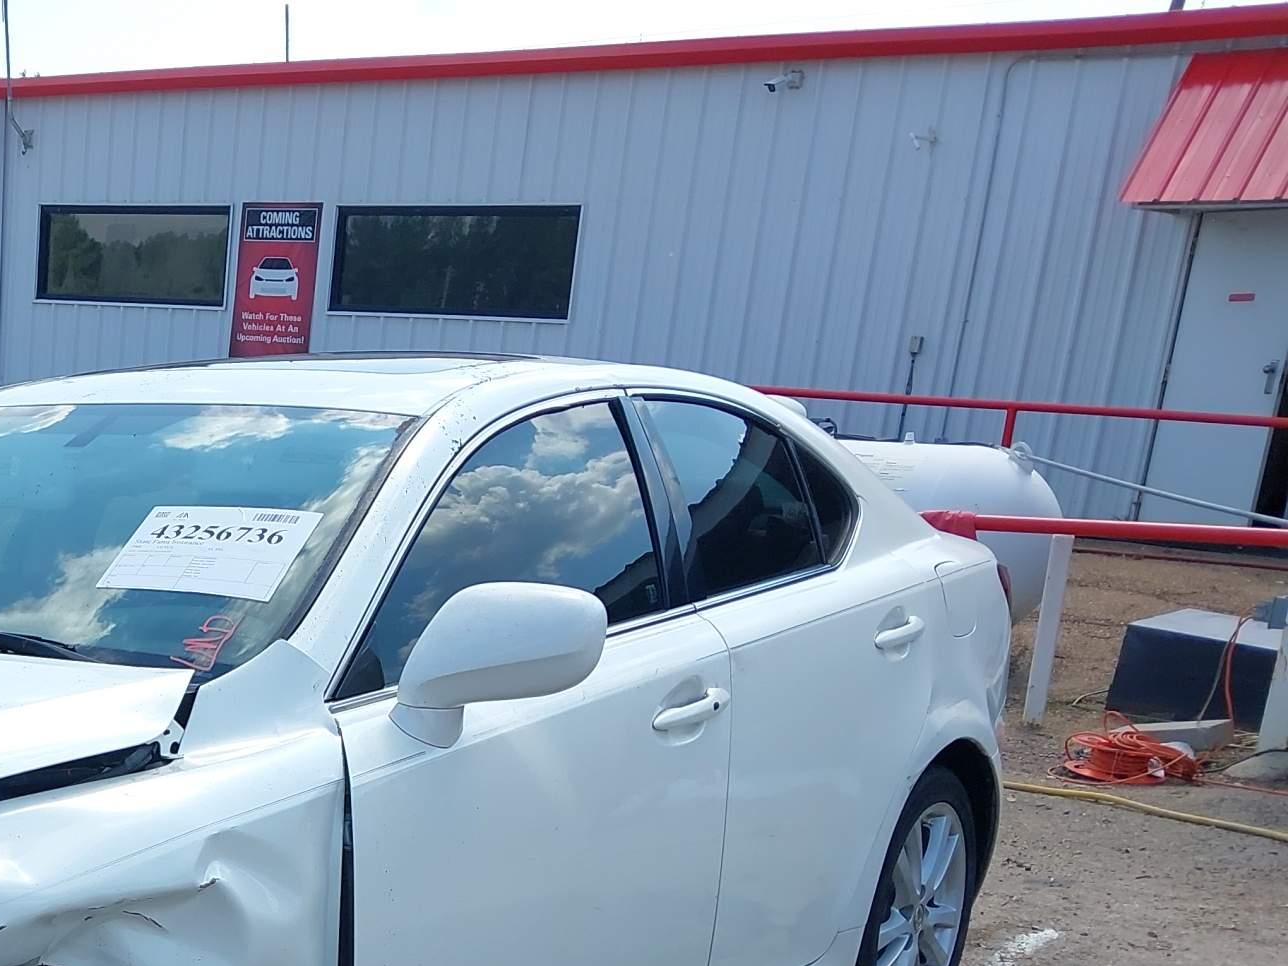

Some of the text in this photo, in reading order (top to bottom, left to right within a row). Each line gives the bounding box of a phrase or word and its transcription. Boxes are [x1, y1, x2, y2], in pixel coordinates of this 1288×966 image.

[260, 211, 300, 225] COMING
[246, 226, 312, 239] ATTRACTIONS
[241, 311, 302, 322] Watch For These
[242, 322, 299, 333] Vehicles At An
[236, 333, 305, 344] Upcoming Auction!
[150, 524, 289, 545] 43256736
